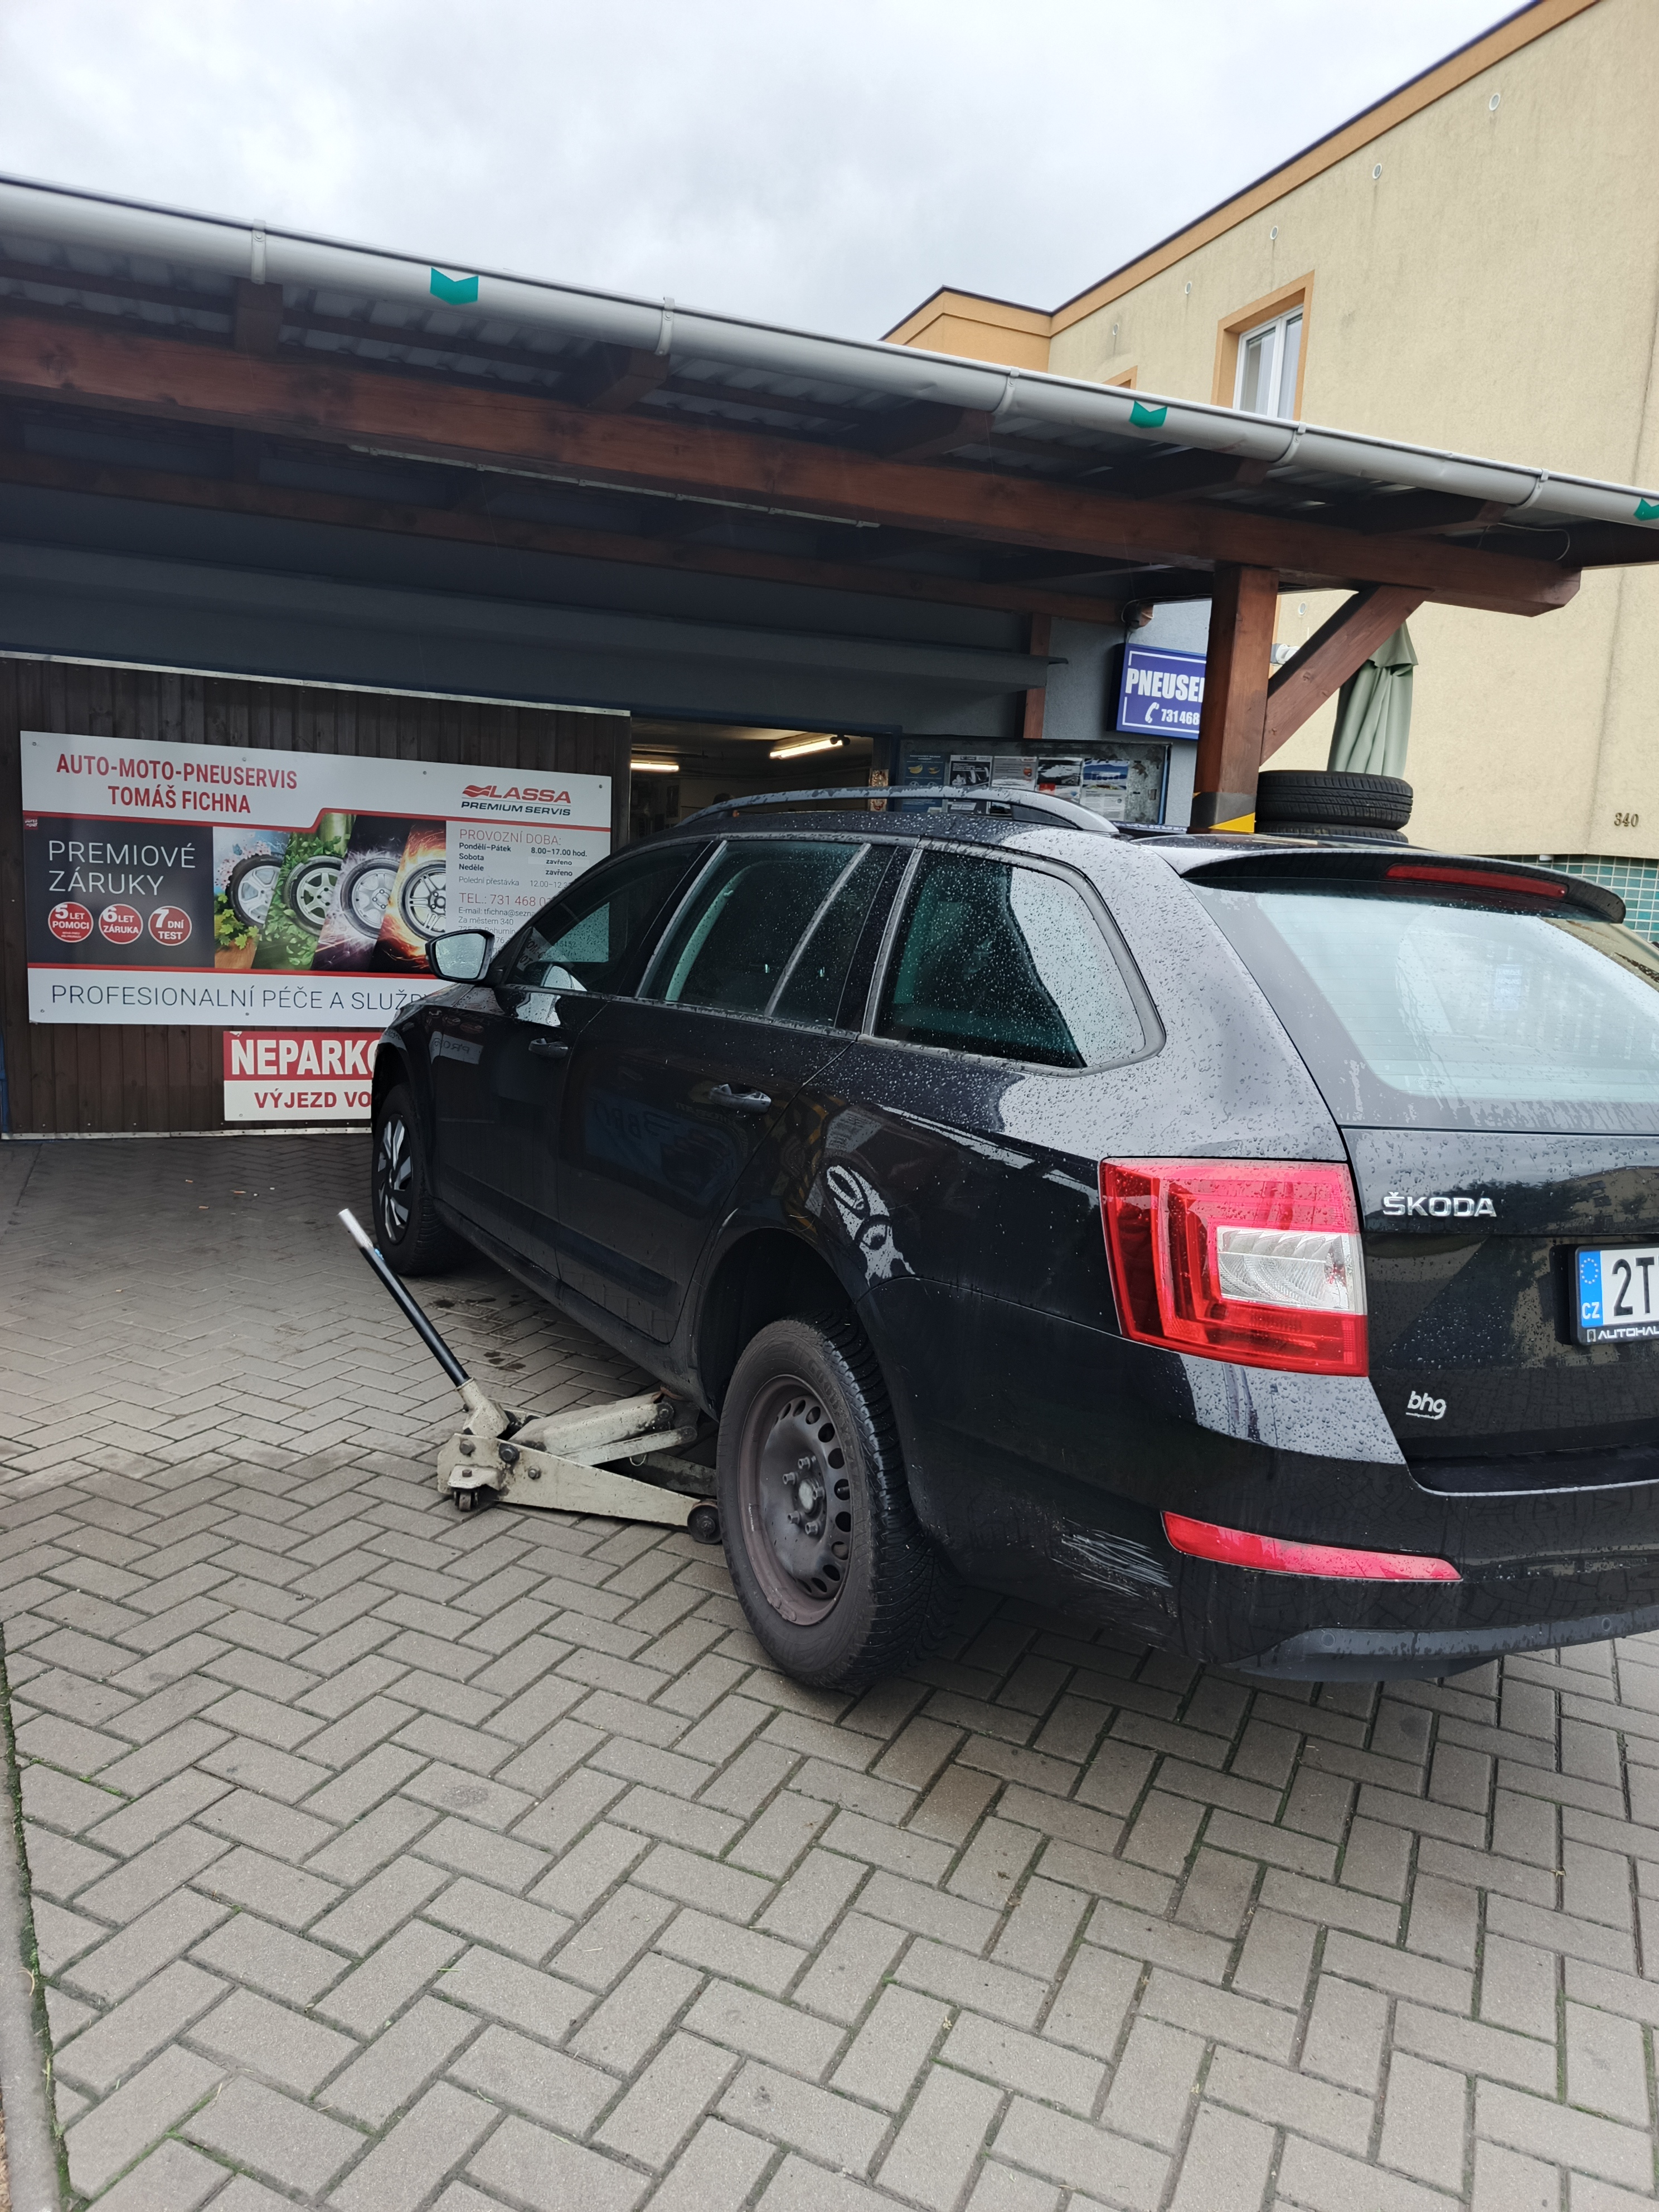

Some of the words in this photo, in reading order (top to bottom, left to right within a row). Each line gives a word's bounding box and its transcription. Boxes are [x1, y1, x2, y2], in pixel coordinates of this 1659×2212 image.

[56, 753, 298, 789] AUTO-MOTO-PNEUSERVIS
[108, 784, 176, 809] TOMÁŠ
[182, 790, 251, 813] FICHNA
[489, 785, 571, 803] LASSA
[461, 801, 523, 814] PREMIUM
[525, 805, 571, 816] SERVIS
[1614, 812, 1639, 827] 340
[460, 829, 523, 843] PROVOZNÍ
[526, 834, 561, 846] DOBA:
[49, 840, 196, 869] PREMIOVÉ
[49, 866, 164, 896] ZÁRUKY
[486, 878, 520, 886] přestávka
[459, 892, 487, 904] TEL.:
[490, 894, 510, 905] 731
[515, 896, 536, 906] 468
[55, 904, 69, 919] 5
[102, 906, 118, 923] 6
[153, 909, 169, 928] 7
[168, 919, 184, 929] DNÍ
[52, 921, 89, 929] POMOCI
[103, 924, 139, 934] ZÁRUKA
[158, 931, 182, 940] TEST
[52, 984, 254, 1007] PROFESIONALNÍ
[263, 986, 323, 1009] PÉČE
[329, 992, 344, 1009] A
[351, 989, 426, 1010] SLUŽ
[254, 1088, 337, 1108] VÝJEZD
[344, 1091, 371, 1108] VO
[1382, 1191, 1497, 1217] ŠKODA
[1612, 1256, 1659, 1317] 2T
[1582, 1301, 1600, 1320] CZ
[1406, 1391, 1447, 1419] bhg
